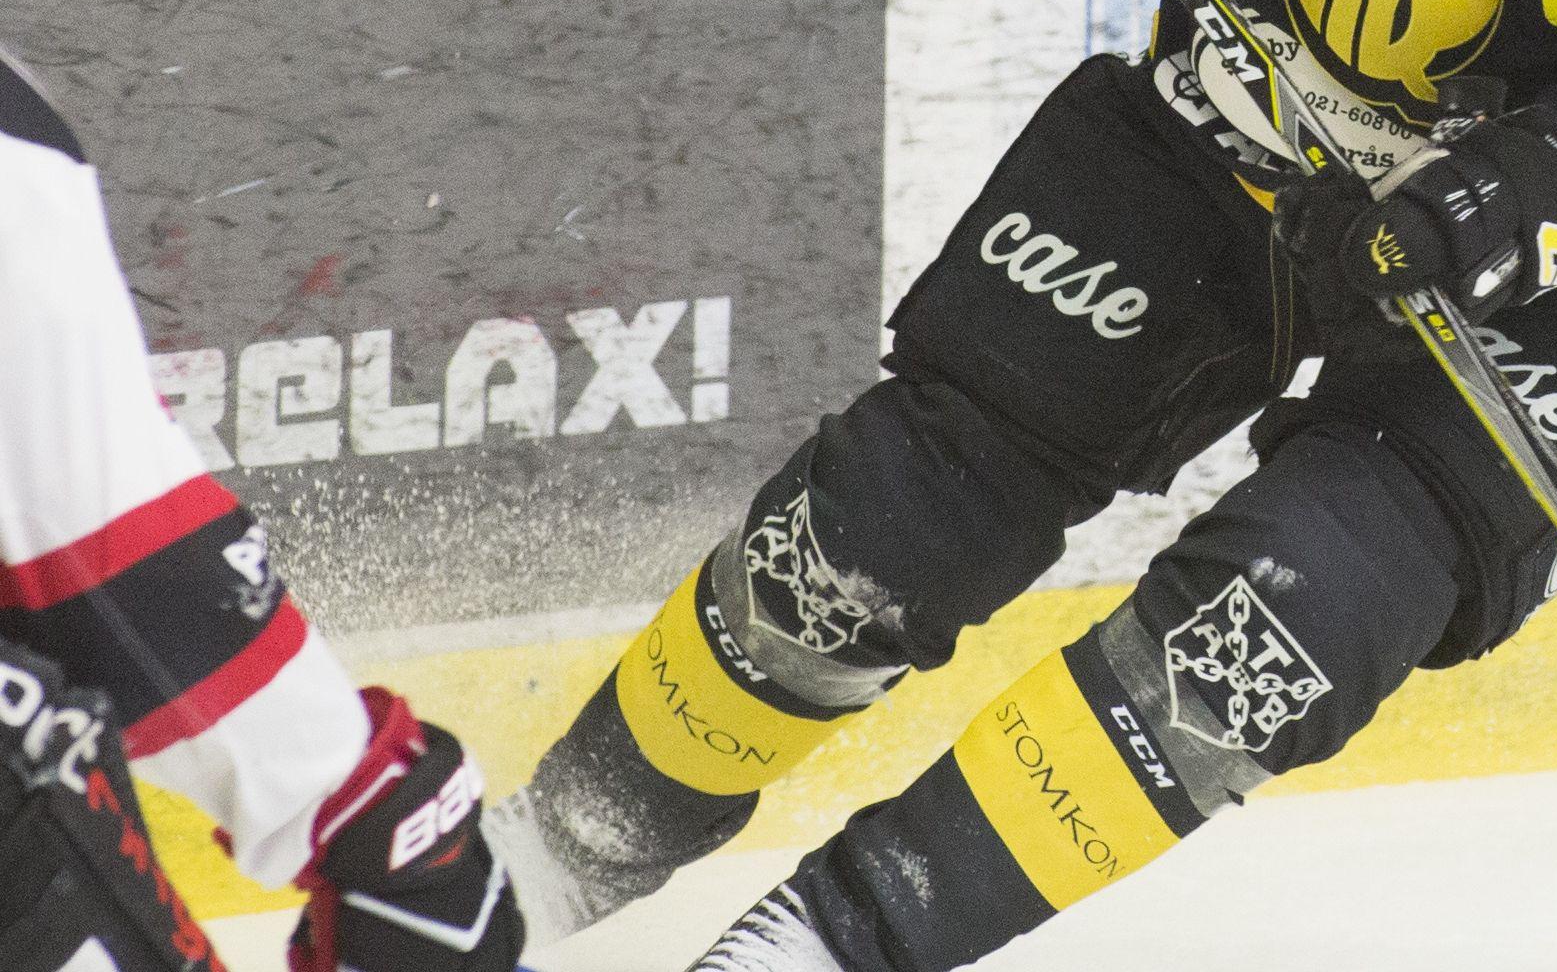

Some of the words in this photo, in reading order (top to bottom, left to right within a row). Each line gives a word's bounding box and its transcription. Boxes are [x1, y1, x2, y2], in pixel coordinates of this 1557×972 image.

[980, 212, 1149, 339] case
[647, 613, 777, 766] OMKON
[706, 605, 768, 683] CCM
[1110, 704, 1176, 790] CCM
